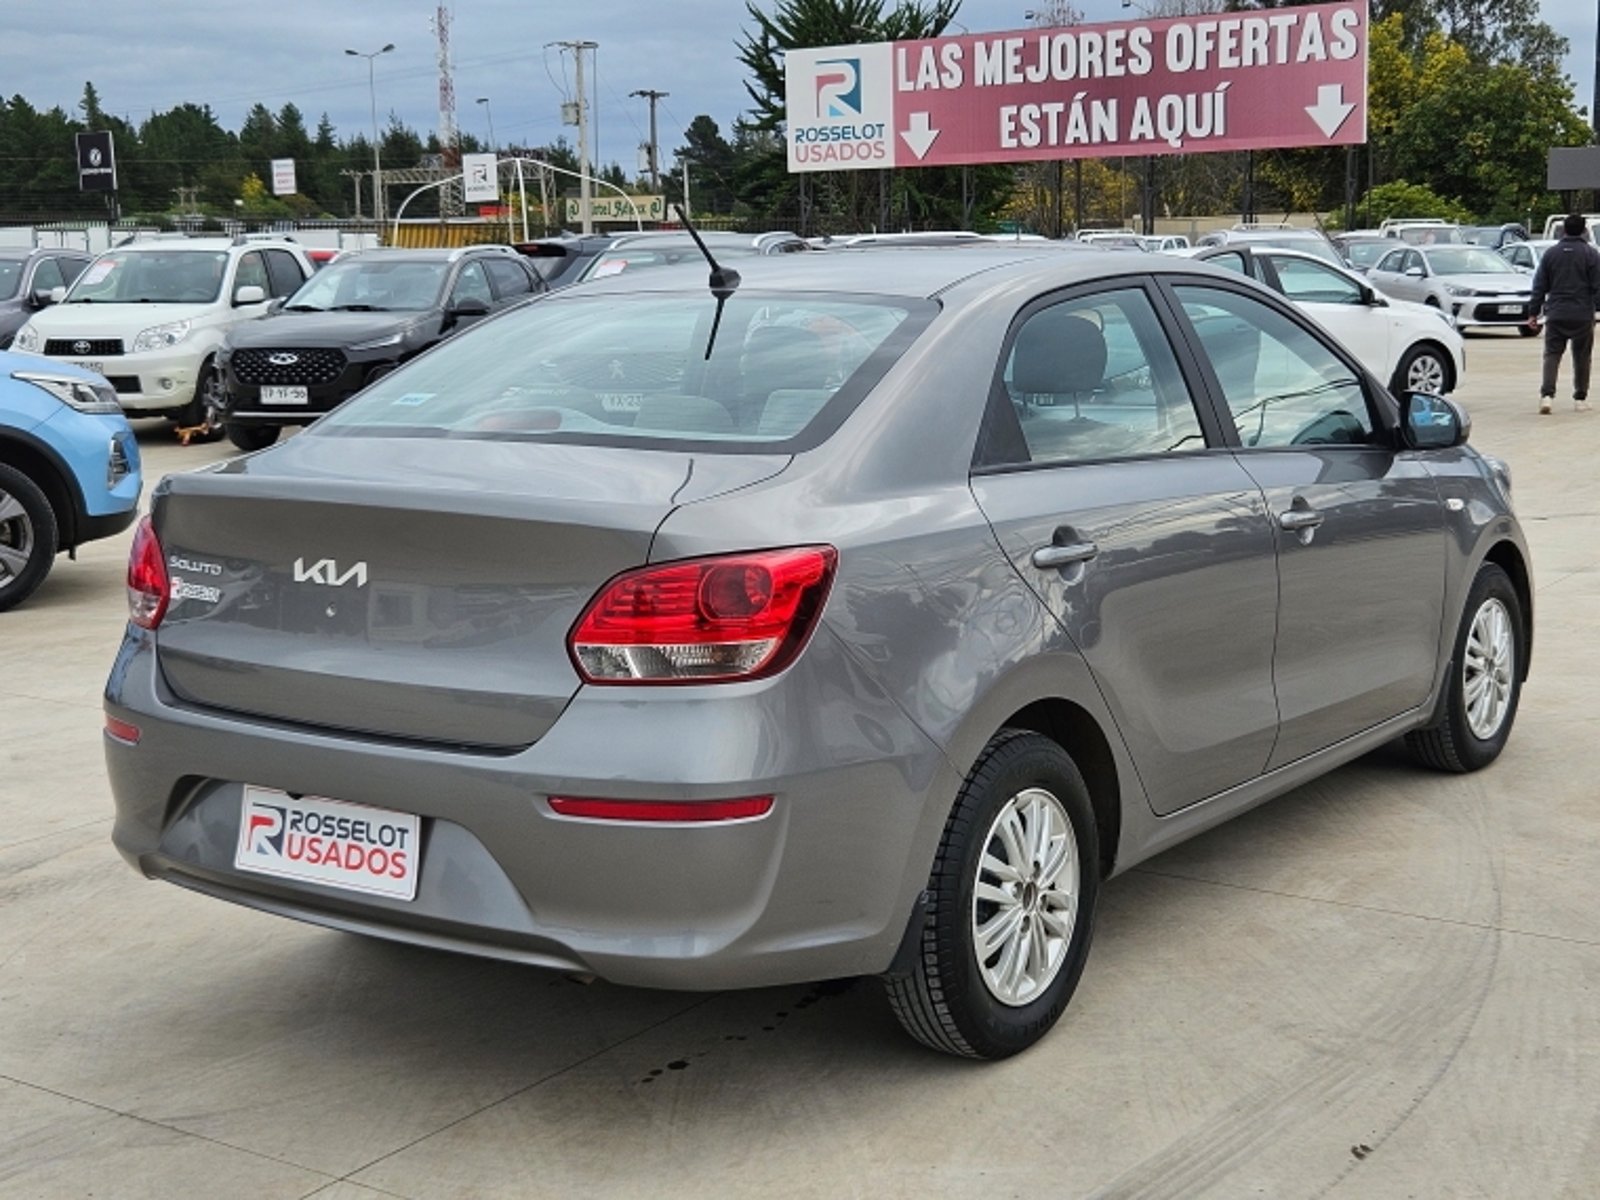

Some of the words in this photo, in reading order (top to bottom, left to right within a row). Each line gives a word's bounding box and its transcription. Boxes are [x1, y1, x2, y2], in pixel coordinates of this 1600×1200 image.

[898, 42, 965, 92] LAS
[974, 27, 1153, 87] MEJORES
[1166, 9, 1360, 73] OFERTAS
[1001, 92, 1118, 148] ESTÁN
[1129, 81, 1233, 149] AQUÍ
[795, 123, 885, 143] ROSSELOT
[795, 141, 885, 163] USADOS
[169, 555, 222, 576] SOLUTO
[294, 557, 367, 588] KIA
[290, 810, 409, 849] ROSSELOT
[287, 833, 407, 879] USADOS
